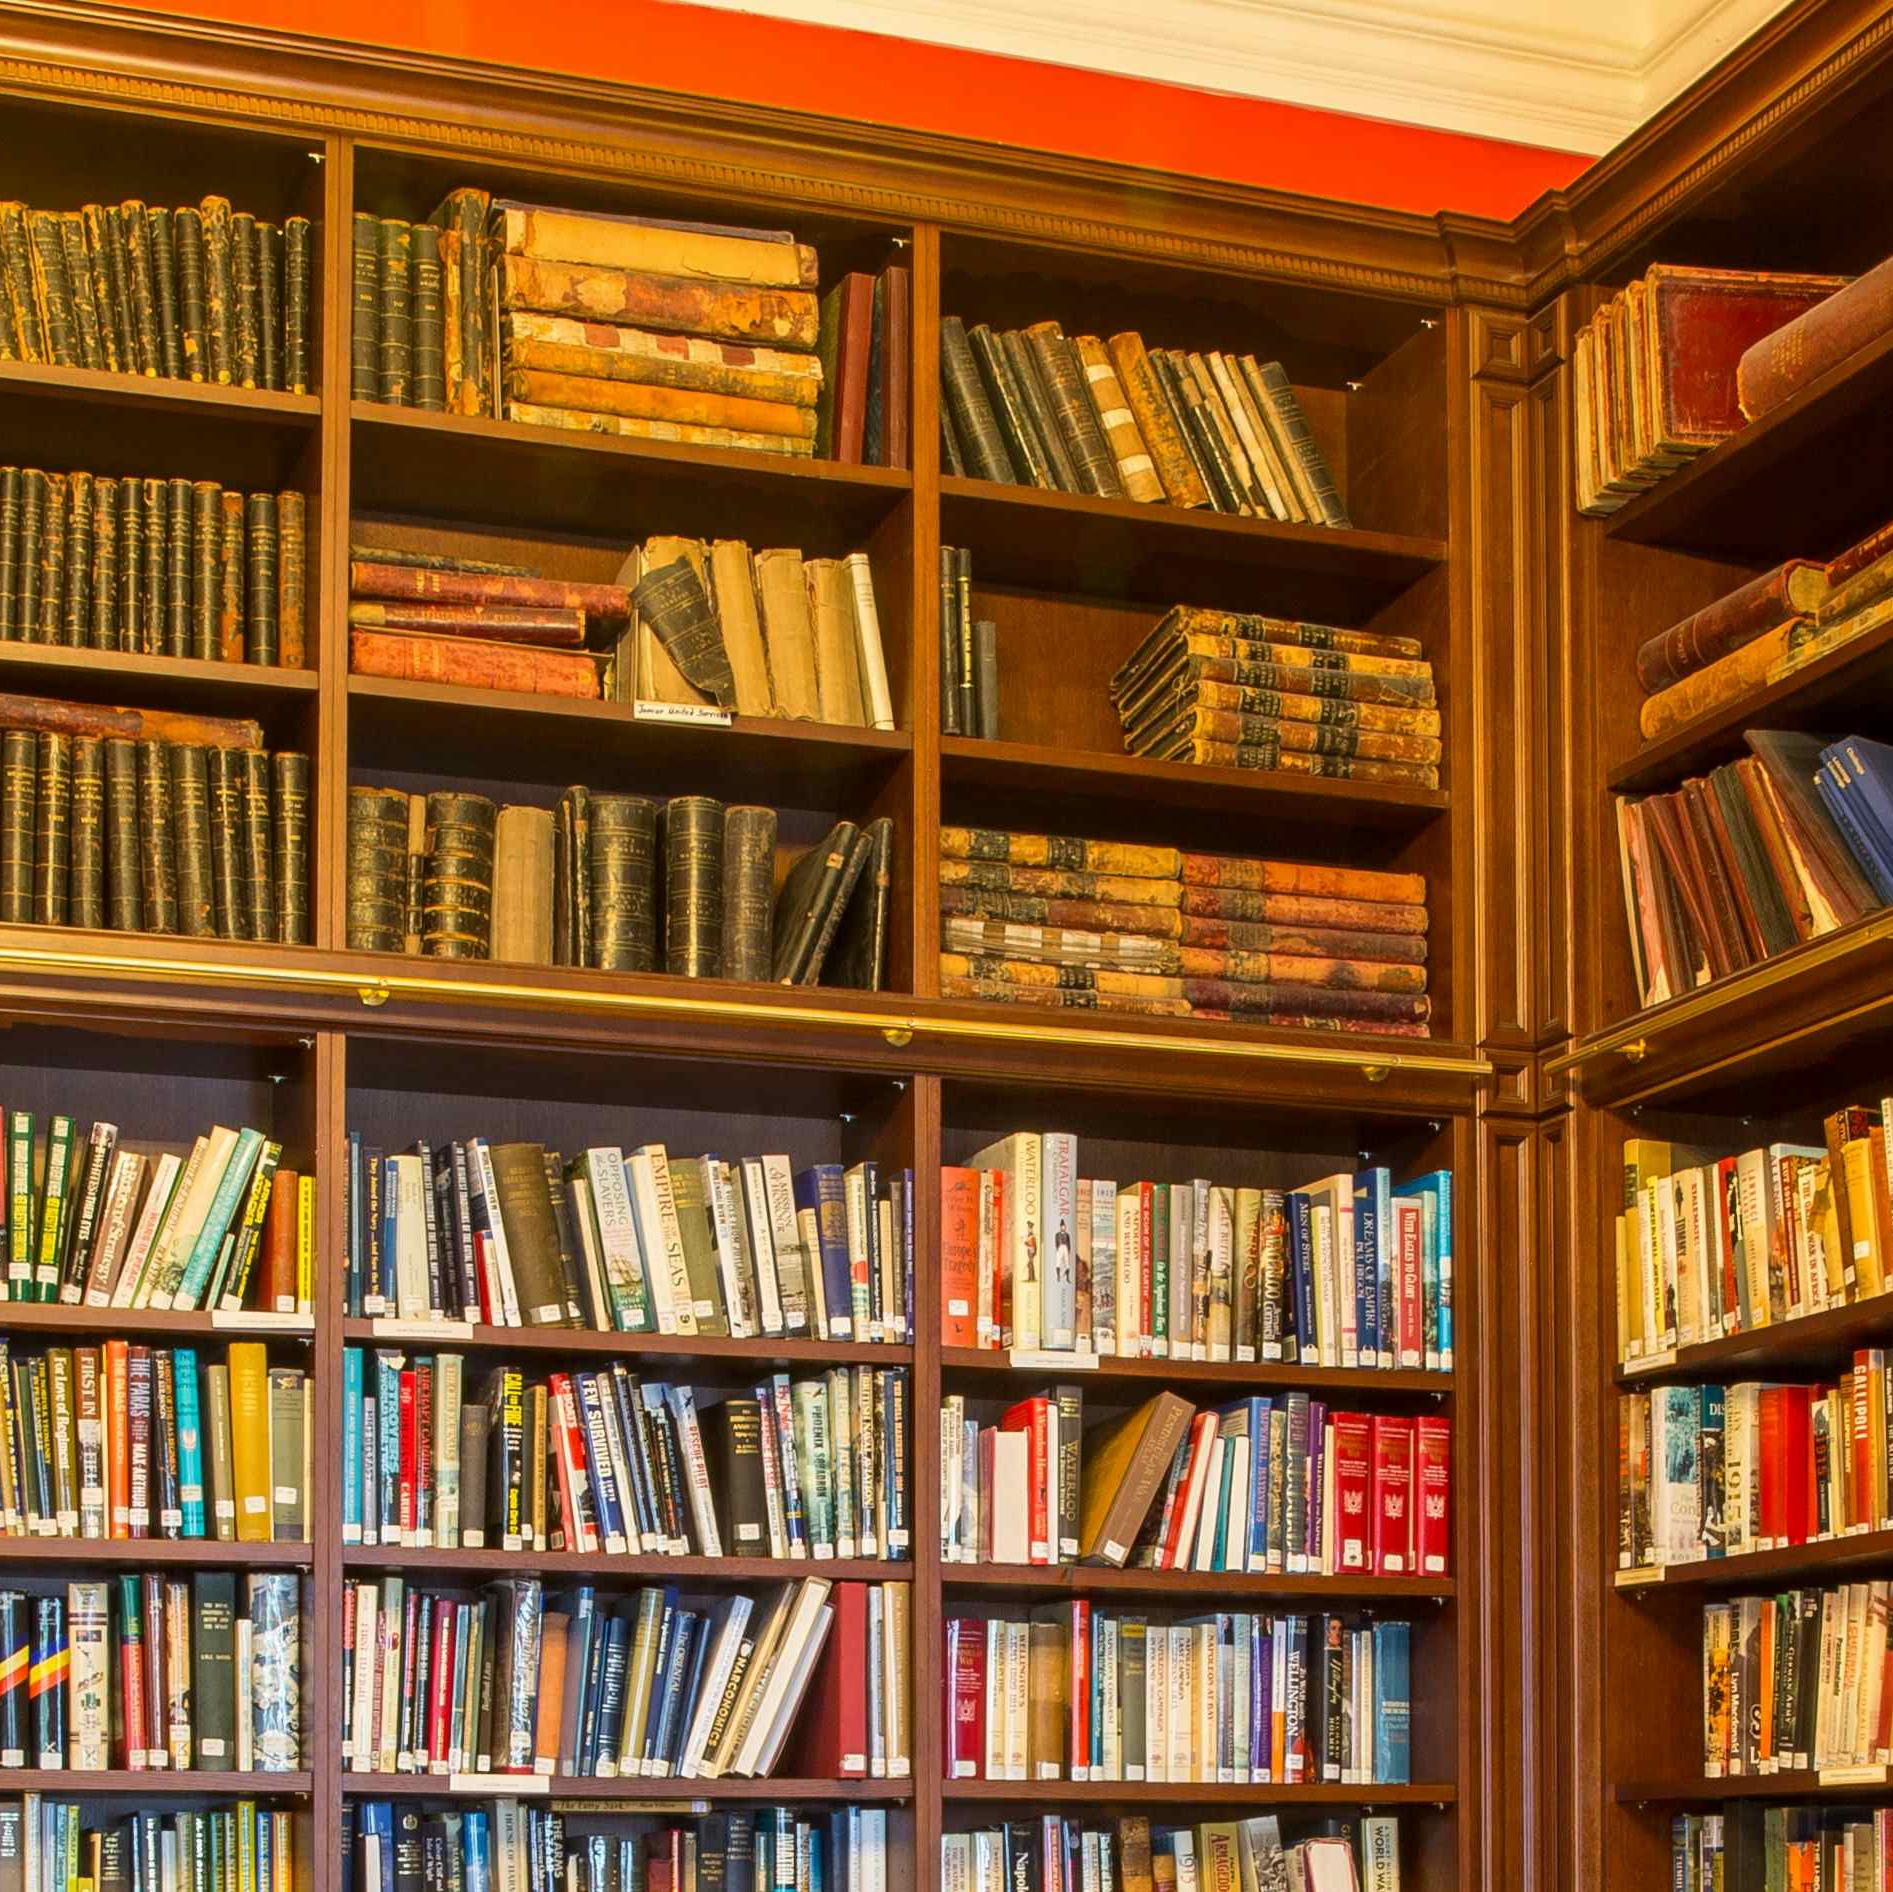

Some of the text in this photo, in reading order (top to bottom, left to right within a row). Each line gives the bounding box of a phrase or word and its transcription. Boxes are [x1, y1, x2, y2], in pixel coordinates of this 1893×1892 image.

[1023, 1139, 1039, 1216] WATERLOO
[1057, 1139, 1071, 1218] TRAFALGAR
[1854, 1365, 1868, 1439] GALLIPOLI
[1375, 1827, 1386, 1870] WORLD
